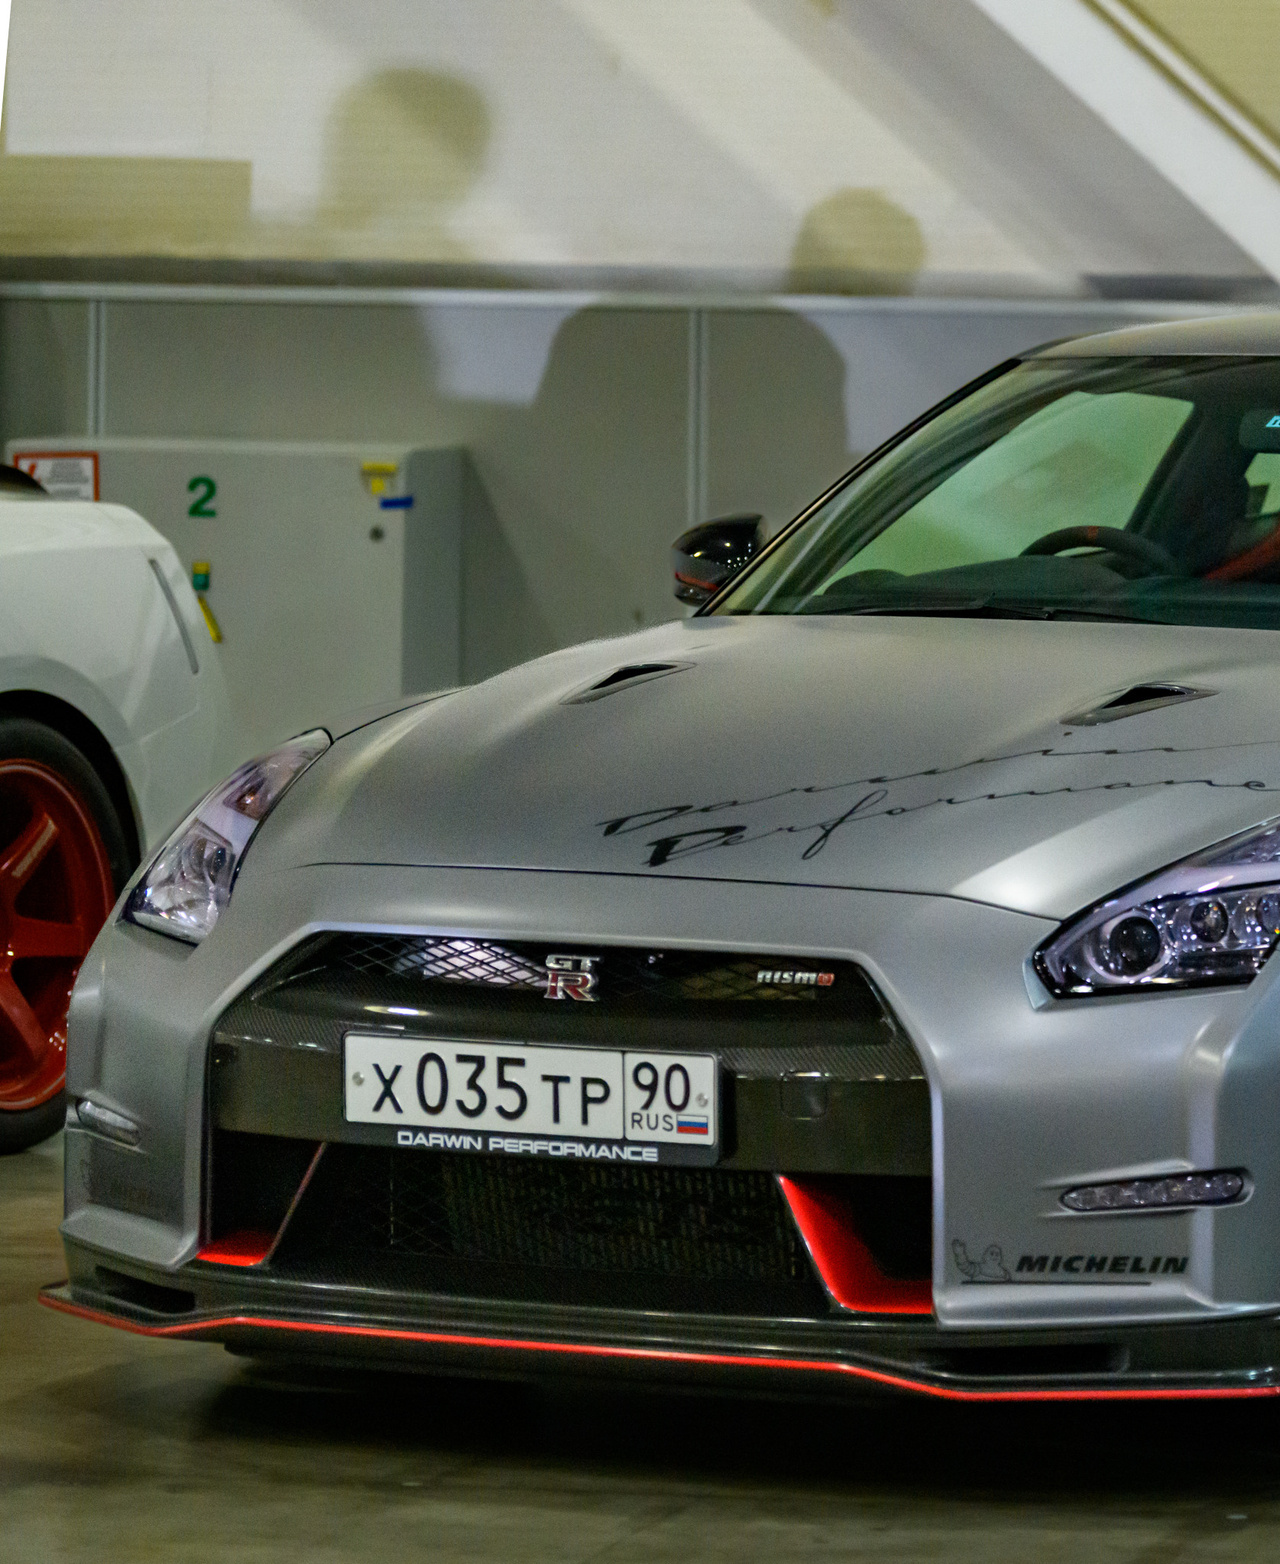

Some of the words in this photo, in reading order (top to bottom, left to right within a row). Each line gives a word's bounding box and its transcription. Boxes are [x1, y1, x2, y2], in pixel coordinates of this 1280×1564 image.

[187, 475, 218, 518] 2
[632, 1061, 691, 1113] 90
[631, 1112, 674, 1133] RUS
[397, 1130, 482, 1151] DARWIN
[488, 1136, 659, 1162] PERFORMANCE
[1015, 1254, 1190, 1275] MICHELIN
